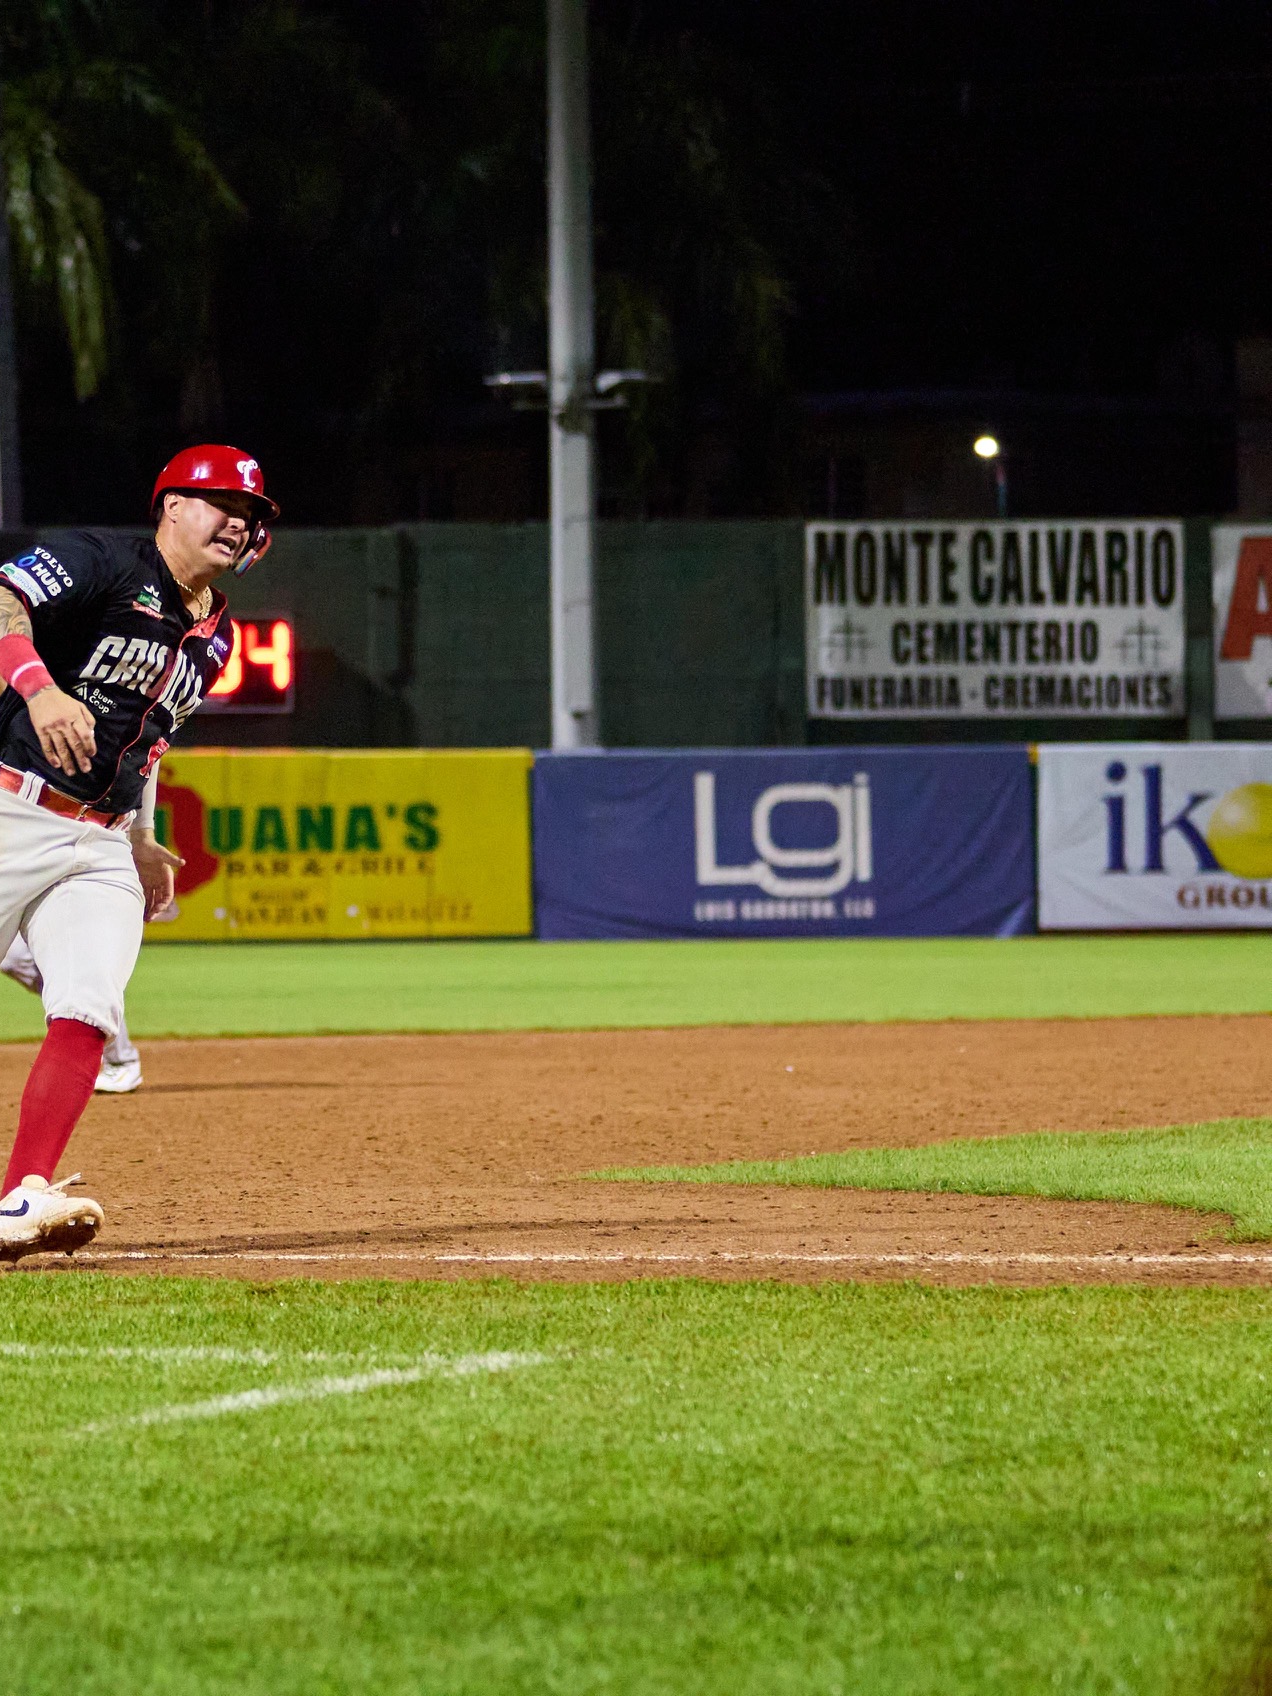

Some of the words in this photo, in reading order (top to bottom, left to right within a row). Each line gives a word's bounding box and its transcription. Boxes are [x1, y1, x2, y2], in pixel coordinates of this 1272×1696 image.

[31, 562, 62, 597] HUB
[34, 547, 74, 588] VOLVO
[814, 531, 959, 606] MONTE
[970, 530, 1176, 608] CALVARIO
[892, 619, 1098, 667] CEMENTERIO
[89, 696, 110, 714] Coop
[815, 675, 961, 709] FUNERARIA
[985, 674, 1172, 709] CREMACIONES
[227, 858, 290, 876] BAR
